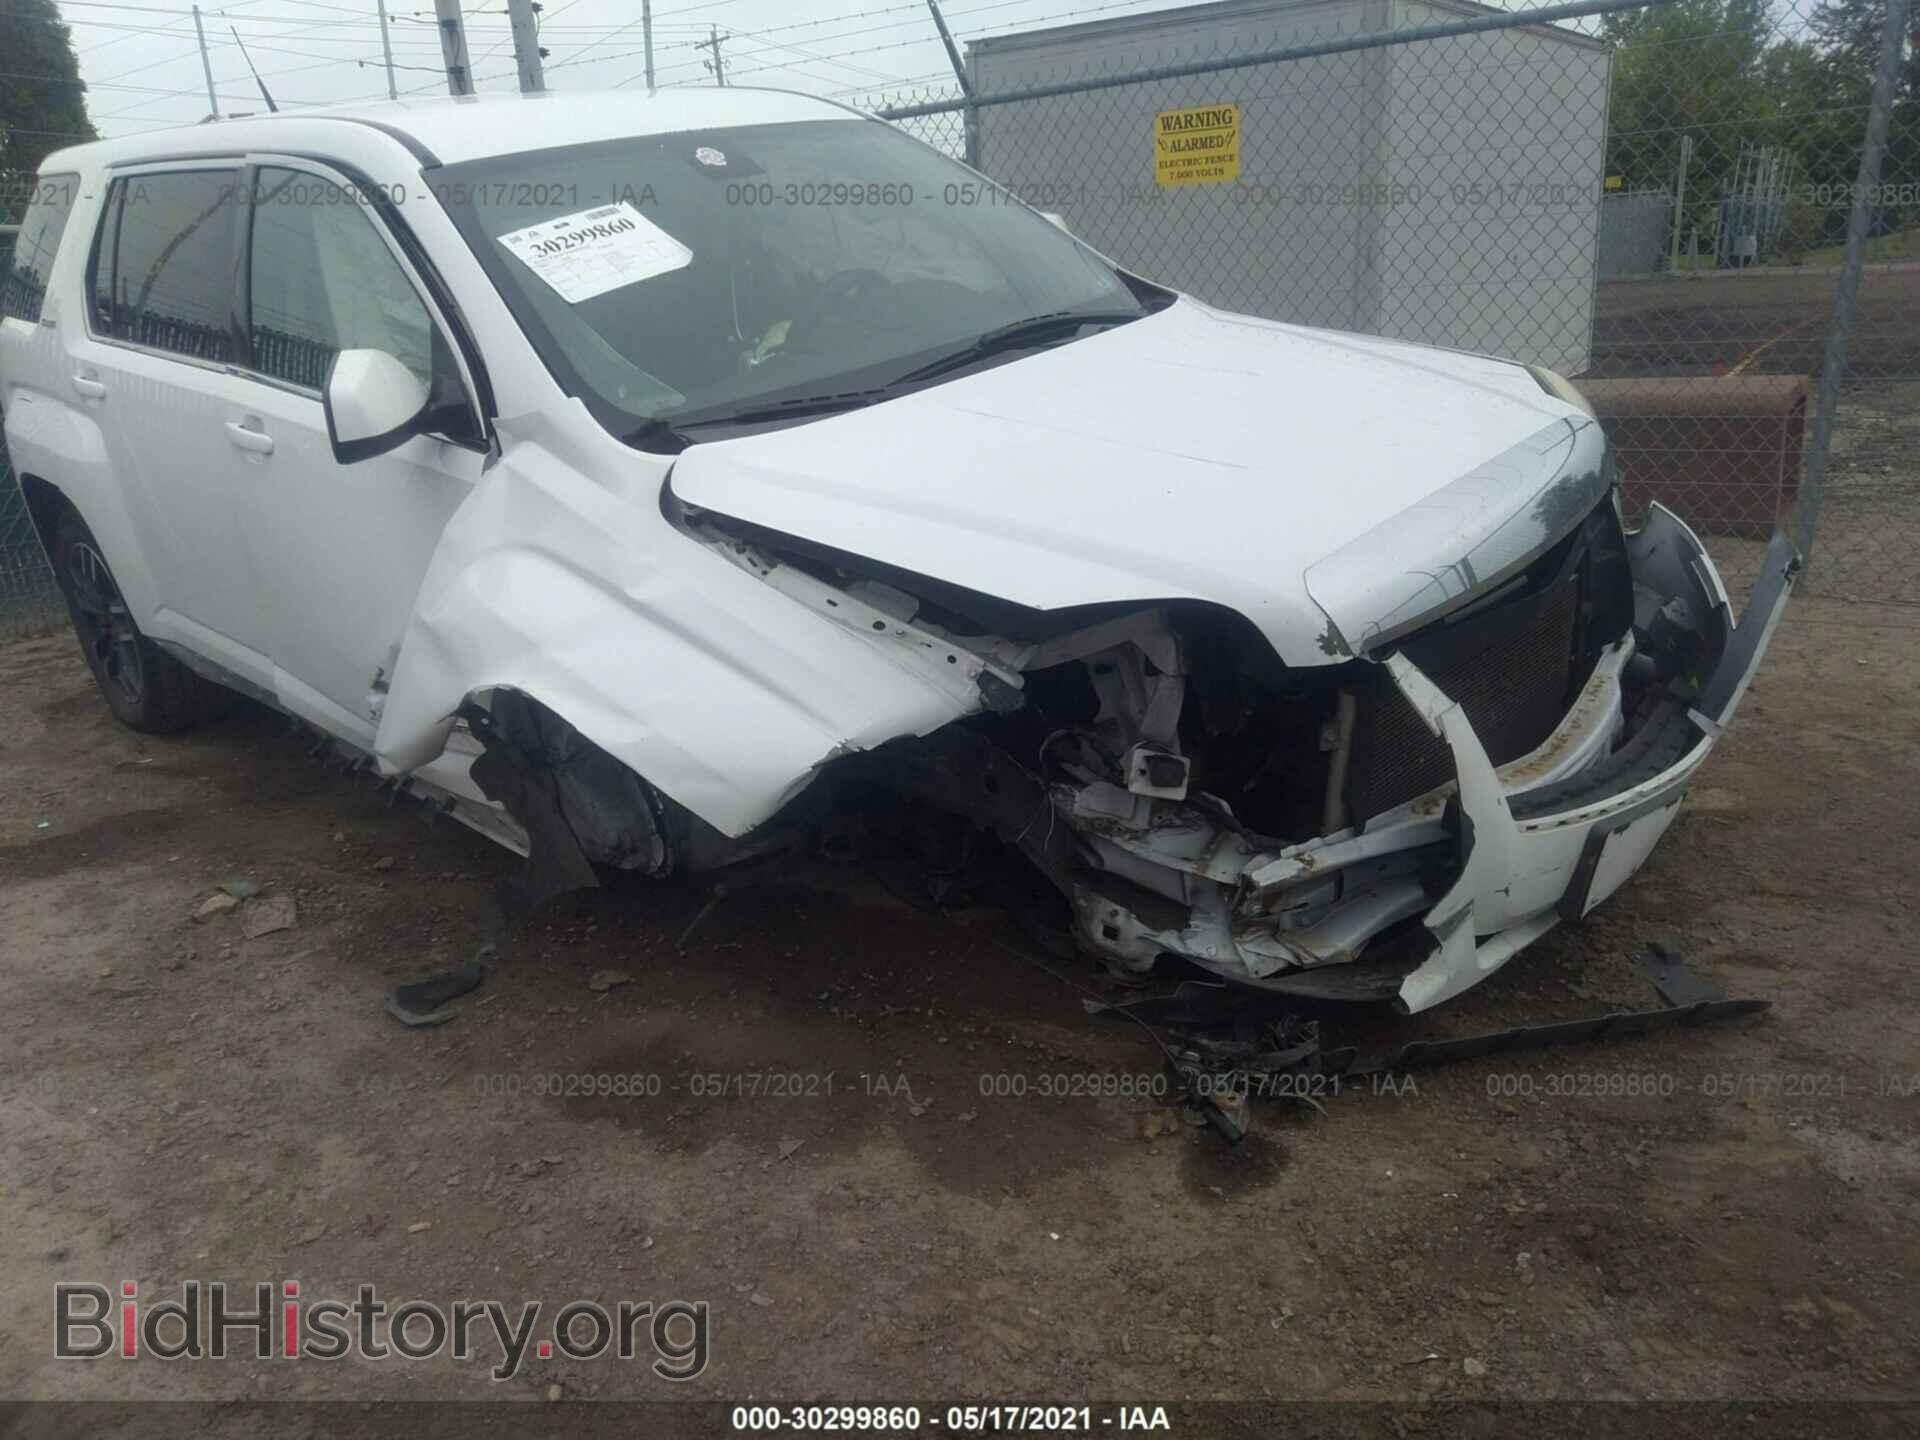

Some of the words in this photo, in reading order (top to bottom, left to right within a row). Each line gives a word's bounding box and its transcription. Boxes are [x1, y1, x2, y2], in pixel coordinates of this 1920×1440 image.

[1161, 109, 1232, 131] WARNING
[1170, 135, 1224, 153] ALARMED
[1159, 157, 1202, 169] ELECTRIC
[1205, 154, 1234, 165] FENCE
[1196, 167, 1225, 178] VOLTS
[530, 217, 636, 258] 30299860
